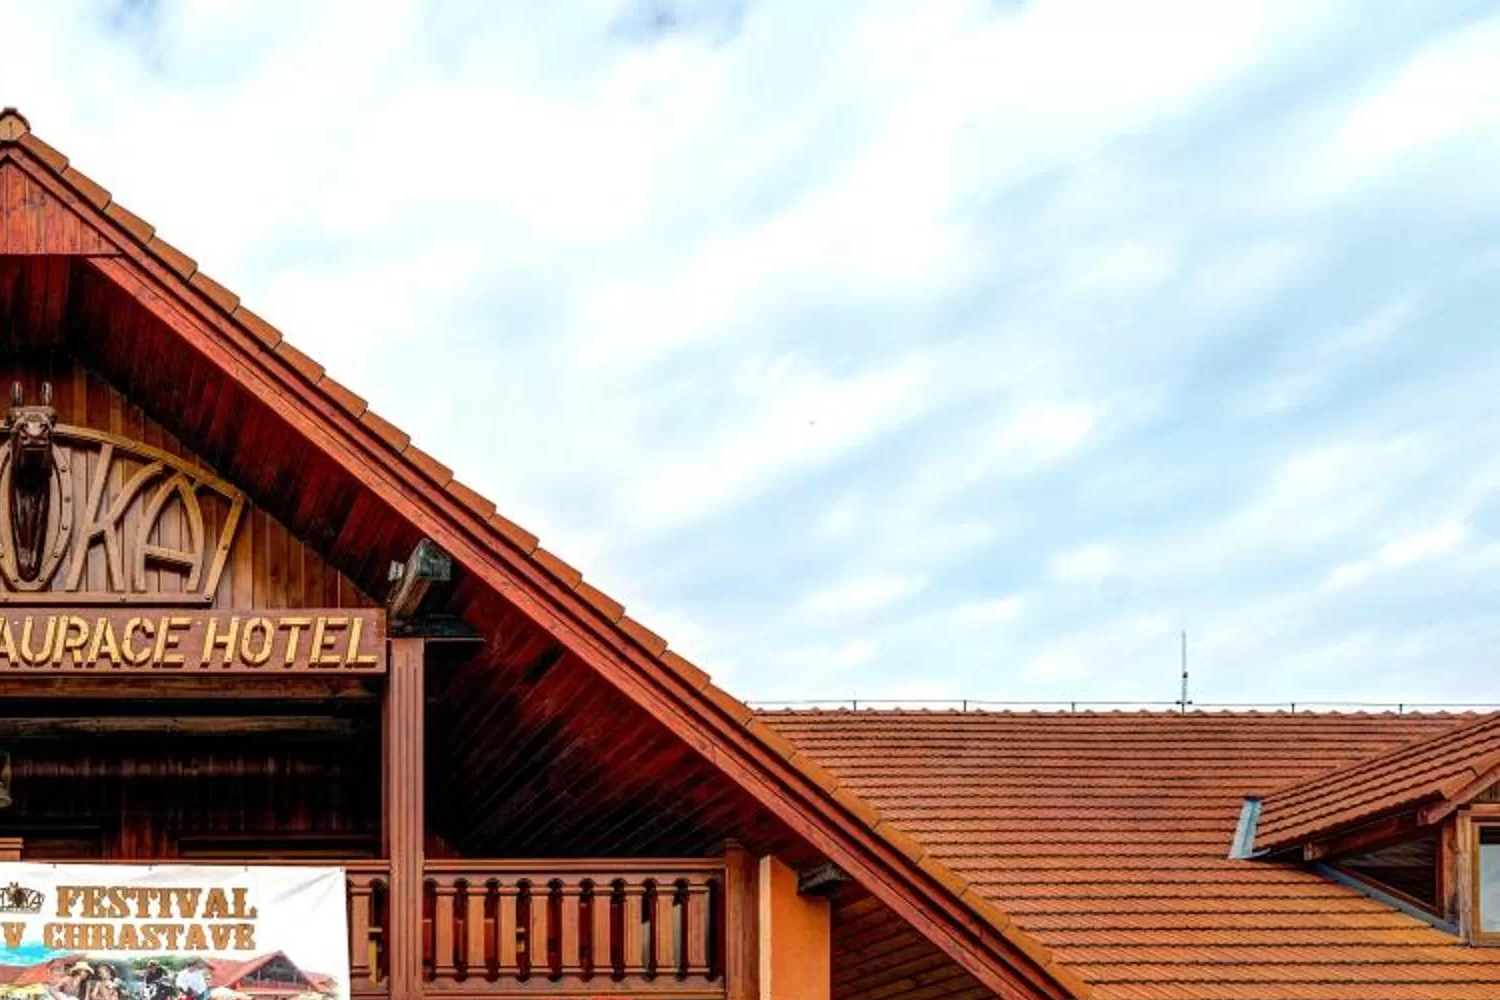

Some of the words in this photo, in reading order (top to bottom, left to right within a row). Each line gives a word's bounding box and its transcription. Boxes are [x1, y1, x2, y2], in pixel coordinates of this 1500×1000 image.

[199, 616, 379, 669] HOTEL
[56, 885, 259, 919] FESTIVAL
[0, 921, 27, 949] V
